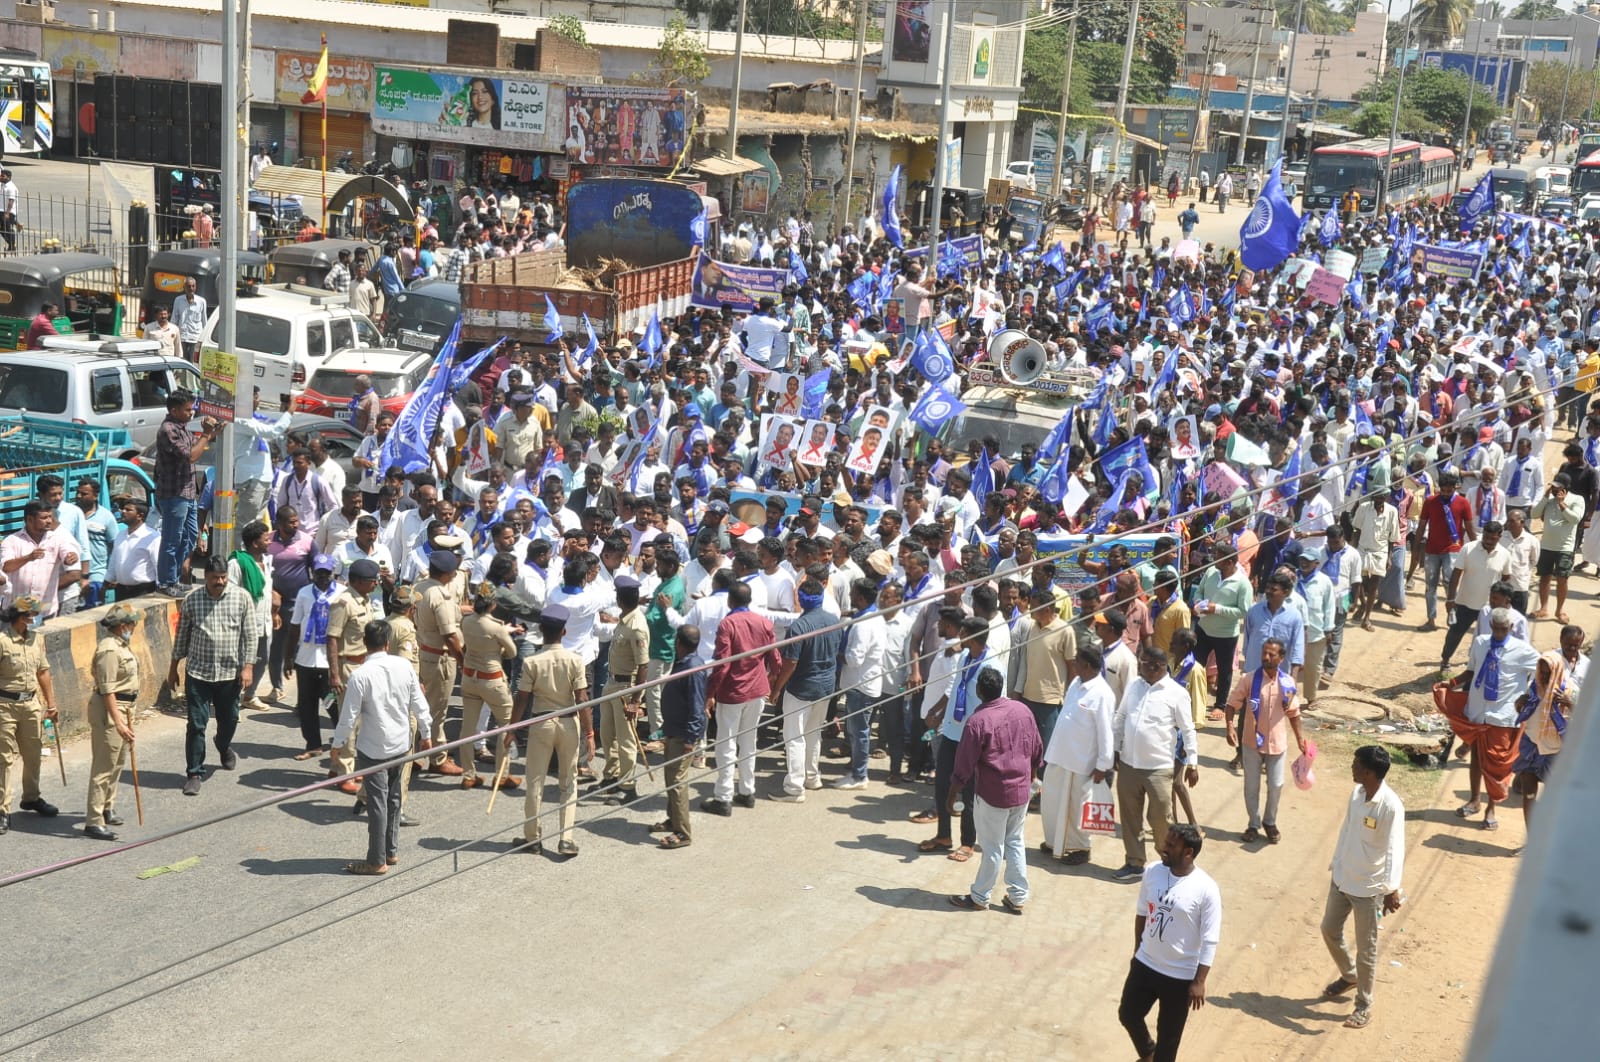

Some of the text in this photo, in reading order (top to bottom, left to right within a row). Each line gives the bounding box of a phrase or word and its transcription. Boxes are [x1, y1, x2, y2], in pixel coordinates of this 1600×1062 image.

[504, 98, 543, 119] ಸ್ಟೋರ್
[520, 122, 543, 130] STORE
[1087, 803, 1115, 821] PK
